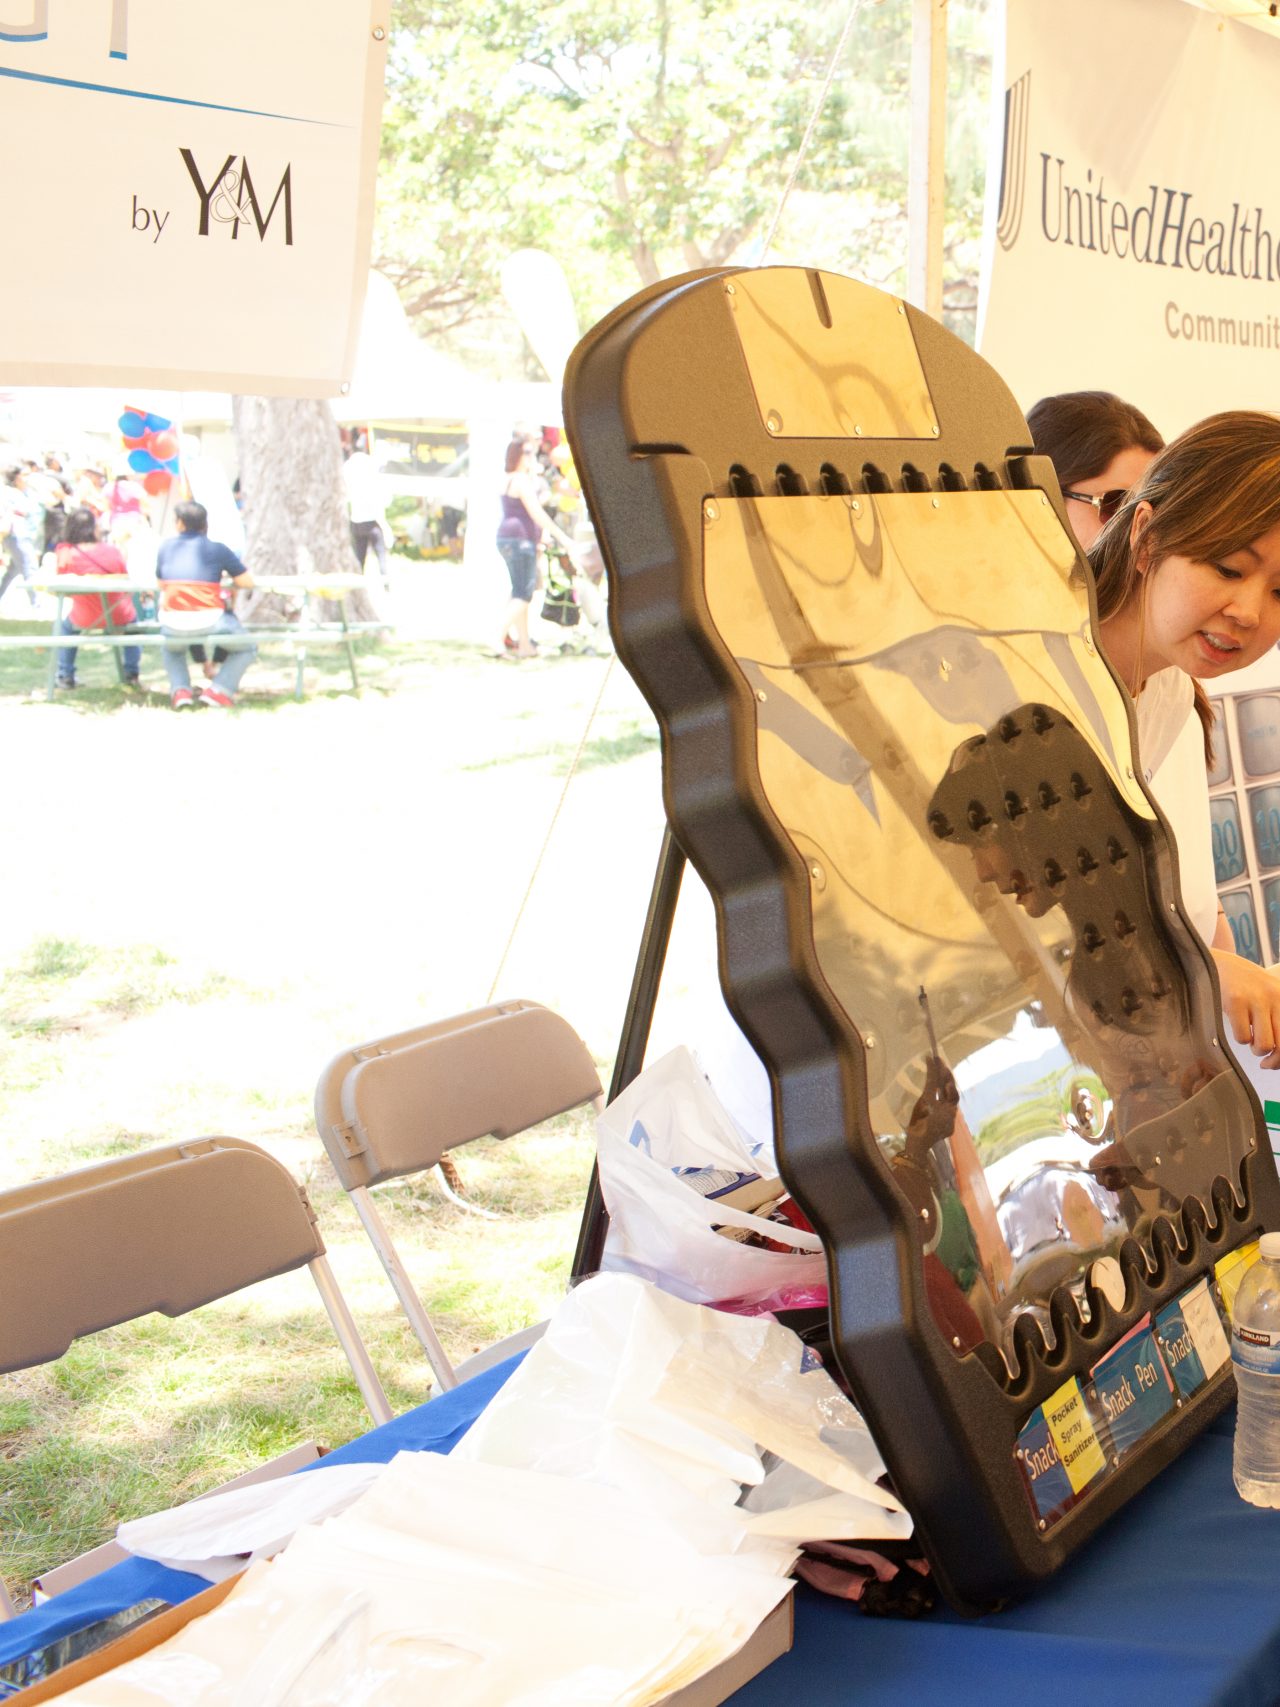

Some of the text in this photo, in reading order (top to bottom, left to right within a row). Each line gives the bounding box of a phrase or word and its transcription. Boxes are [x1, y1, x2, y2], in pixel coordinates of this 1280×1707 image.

[132, 147, 293, 246] by Y&M
[1240, 1330, 1269, 1343] KIRKLAND
[1102, 1362, 1159, 1421] Snack Pen
[1051, 1397, 1078, 1427] Pocket
[1061, 1420, 1083, 1444] Spray
[1064, 1433, 1096, 1468] Sanitizer
